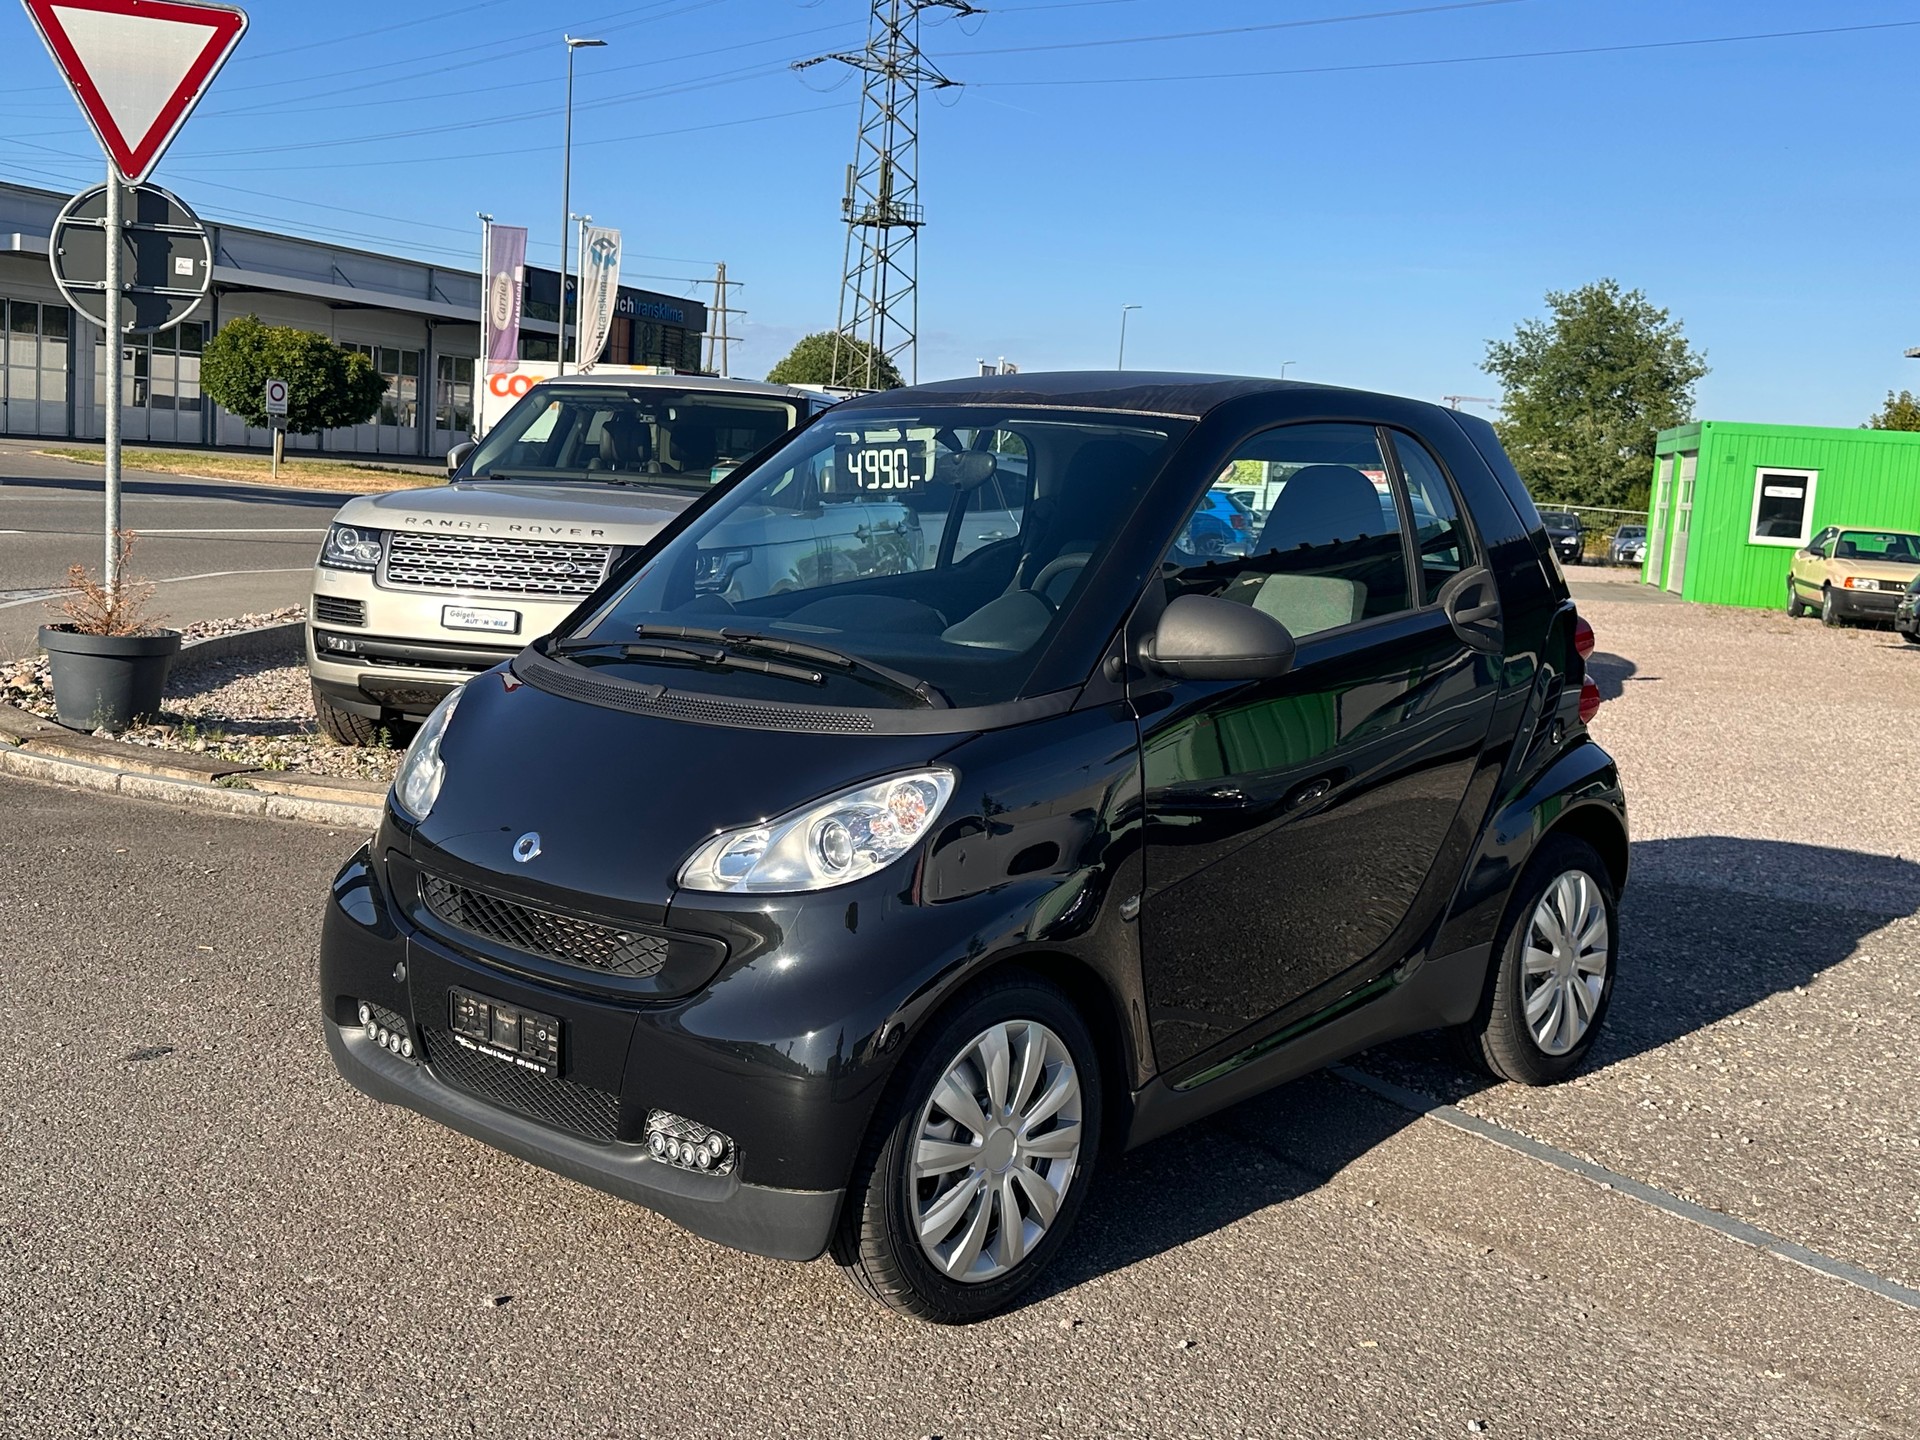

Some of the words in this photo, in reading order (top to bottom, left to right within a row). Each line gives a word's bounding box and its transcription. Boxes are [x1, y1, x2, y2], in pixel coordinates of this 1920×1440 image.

[496, 279, 507, 322] Carrier
[614, 294, 684, 322] ichtransklima
[404, 516, 491, 532] RANGE
[508, 523, 605, 538] ROVER
